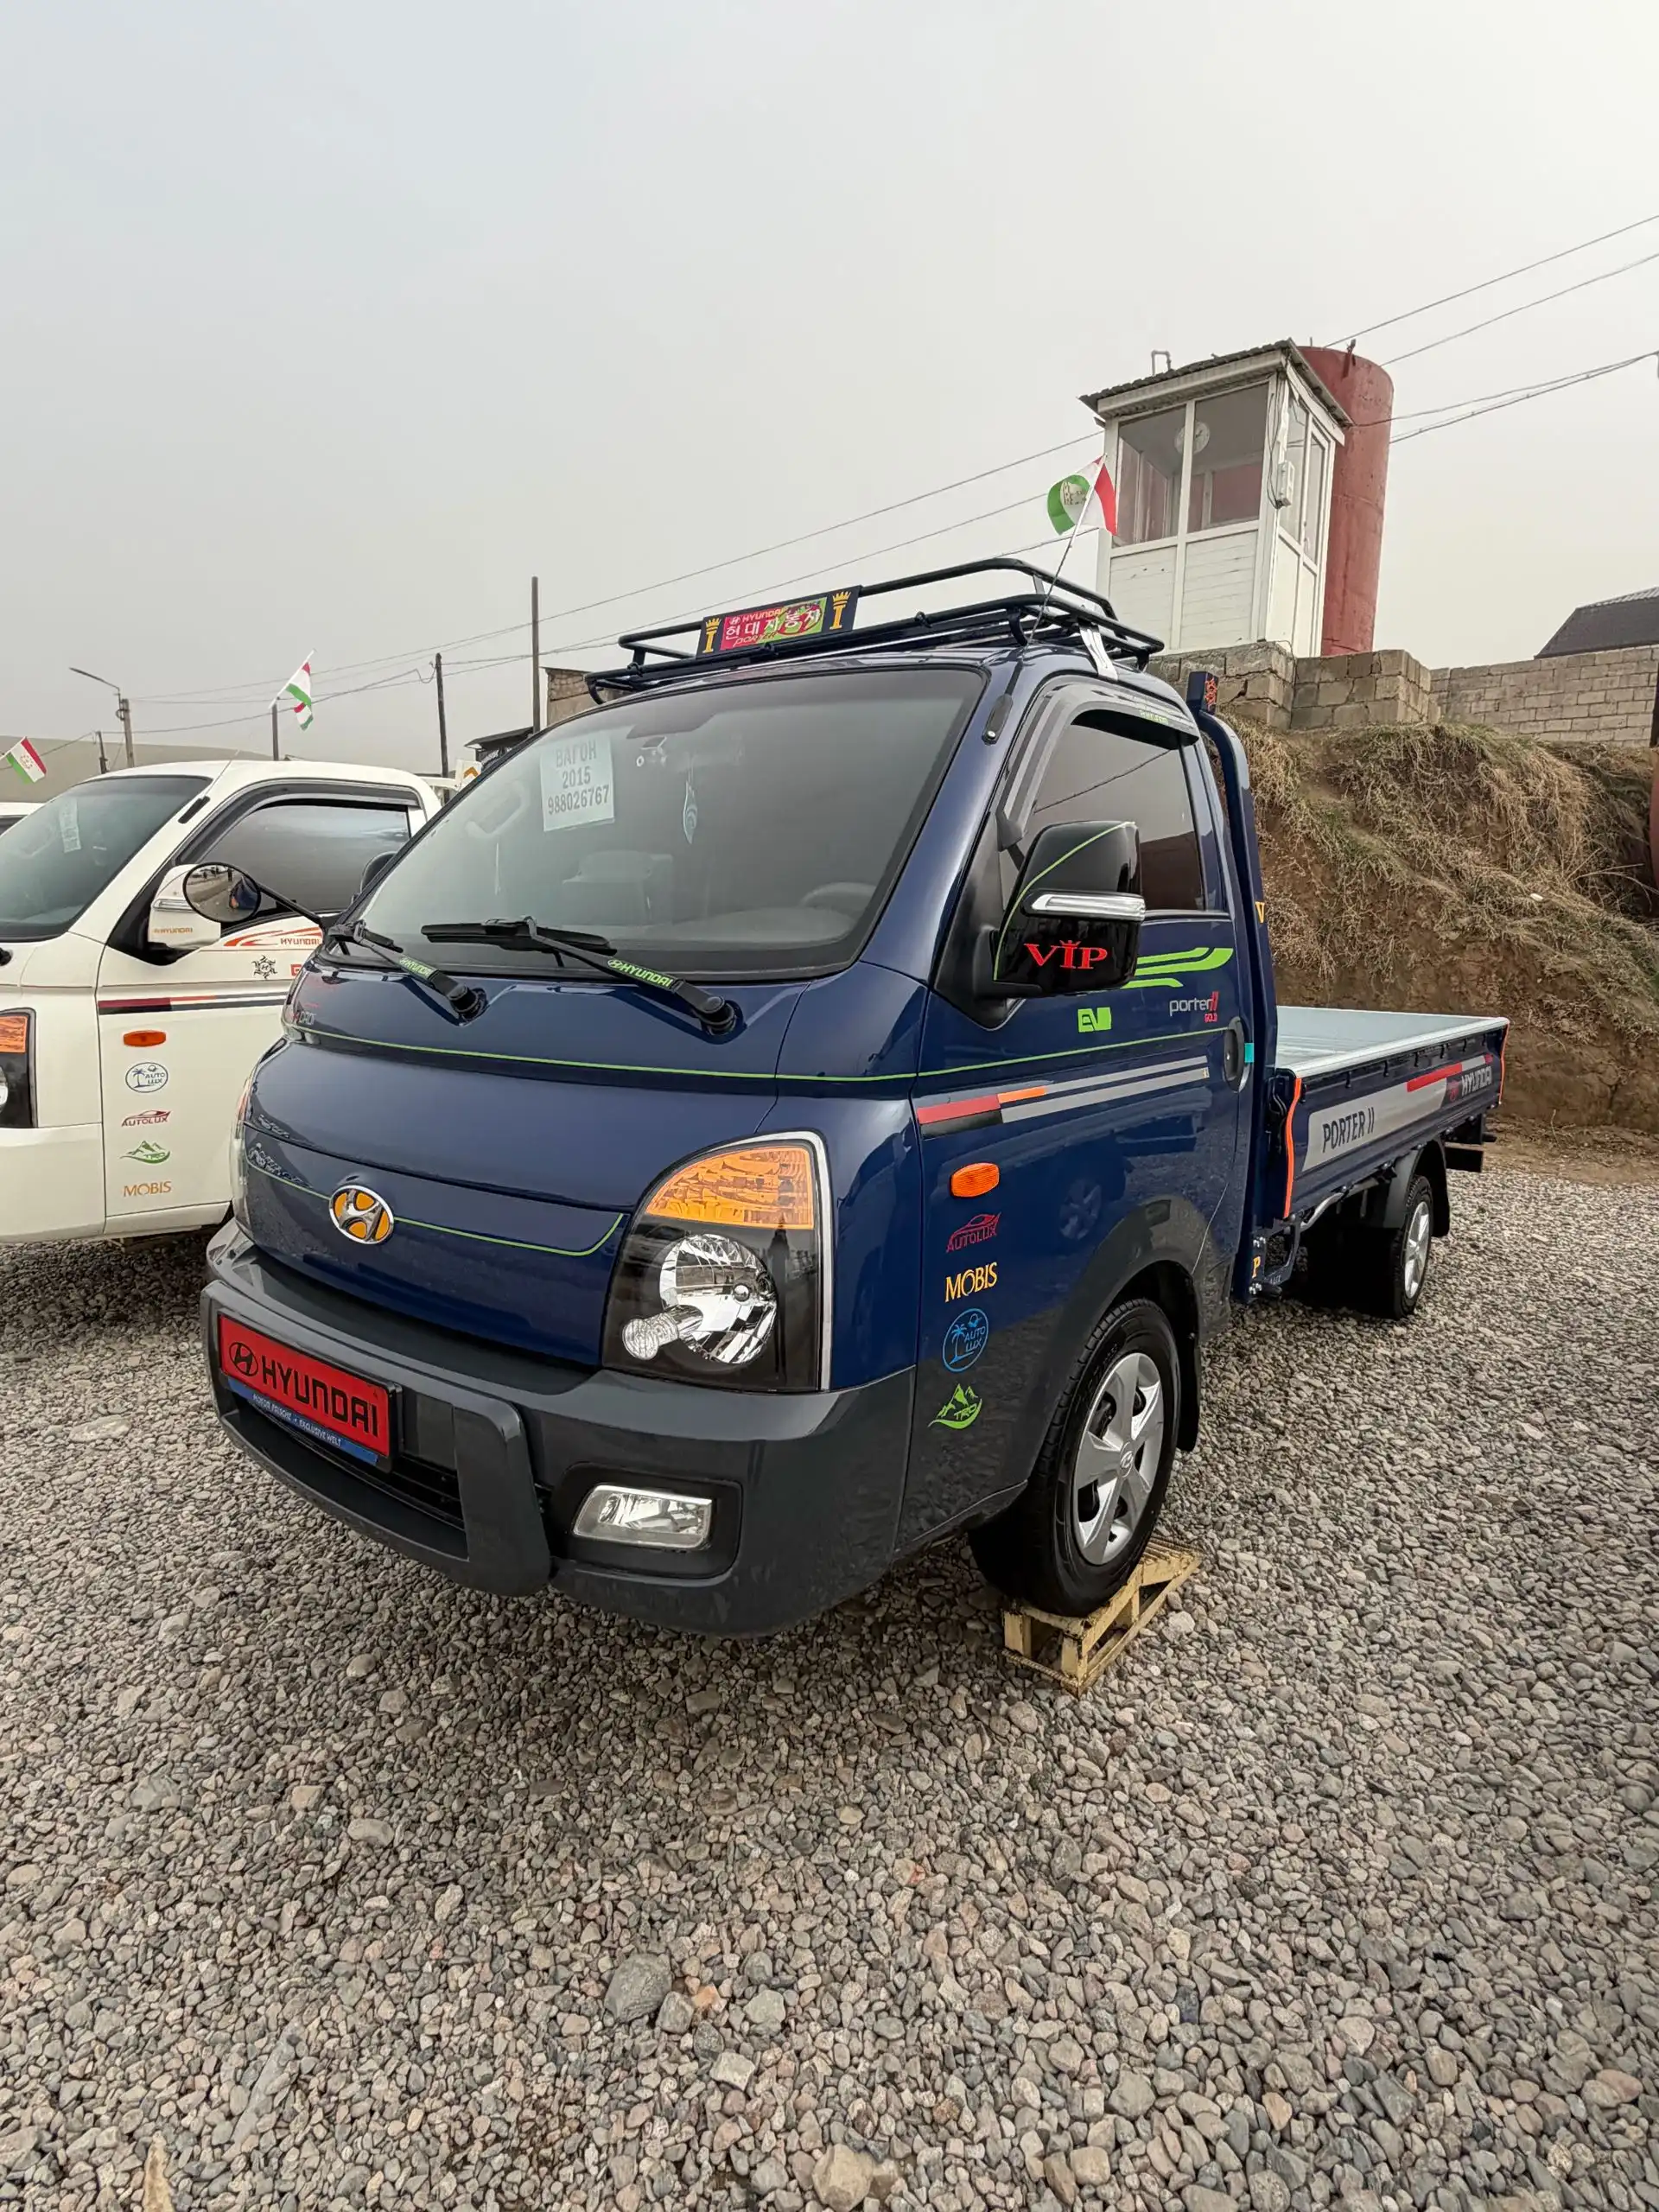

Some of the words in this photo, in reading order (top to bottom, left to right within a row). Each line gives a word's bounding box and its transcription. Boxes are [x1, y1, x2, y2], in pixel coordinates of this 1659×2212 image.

[562, 766, 591, 789] 2015
[547, 785, 609, 816] 988026767
[1024, 941, 1108, 969] VIP
[620, 963, 674, 987] HYUNDAI
[121, 1116, 168, 1127] AUTOLUX
[1322, 1111, 1364, 1154] PORTER
[124, 1180, 172, 1197] MOBIS
[946, 1224, 997, 1253] AUTOLUX
[945, 1262, 998, 1302] MOBIS
[964, 1326, 986, 1343] AUTO
[965, 1338, 982, 1352] LUX
[262, 1355, 378, 1437] HYUNDAI
